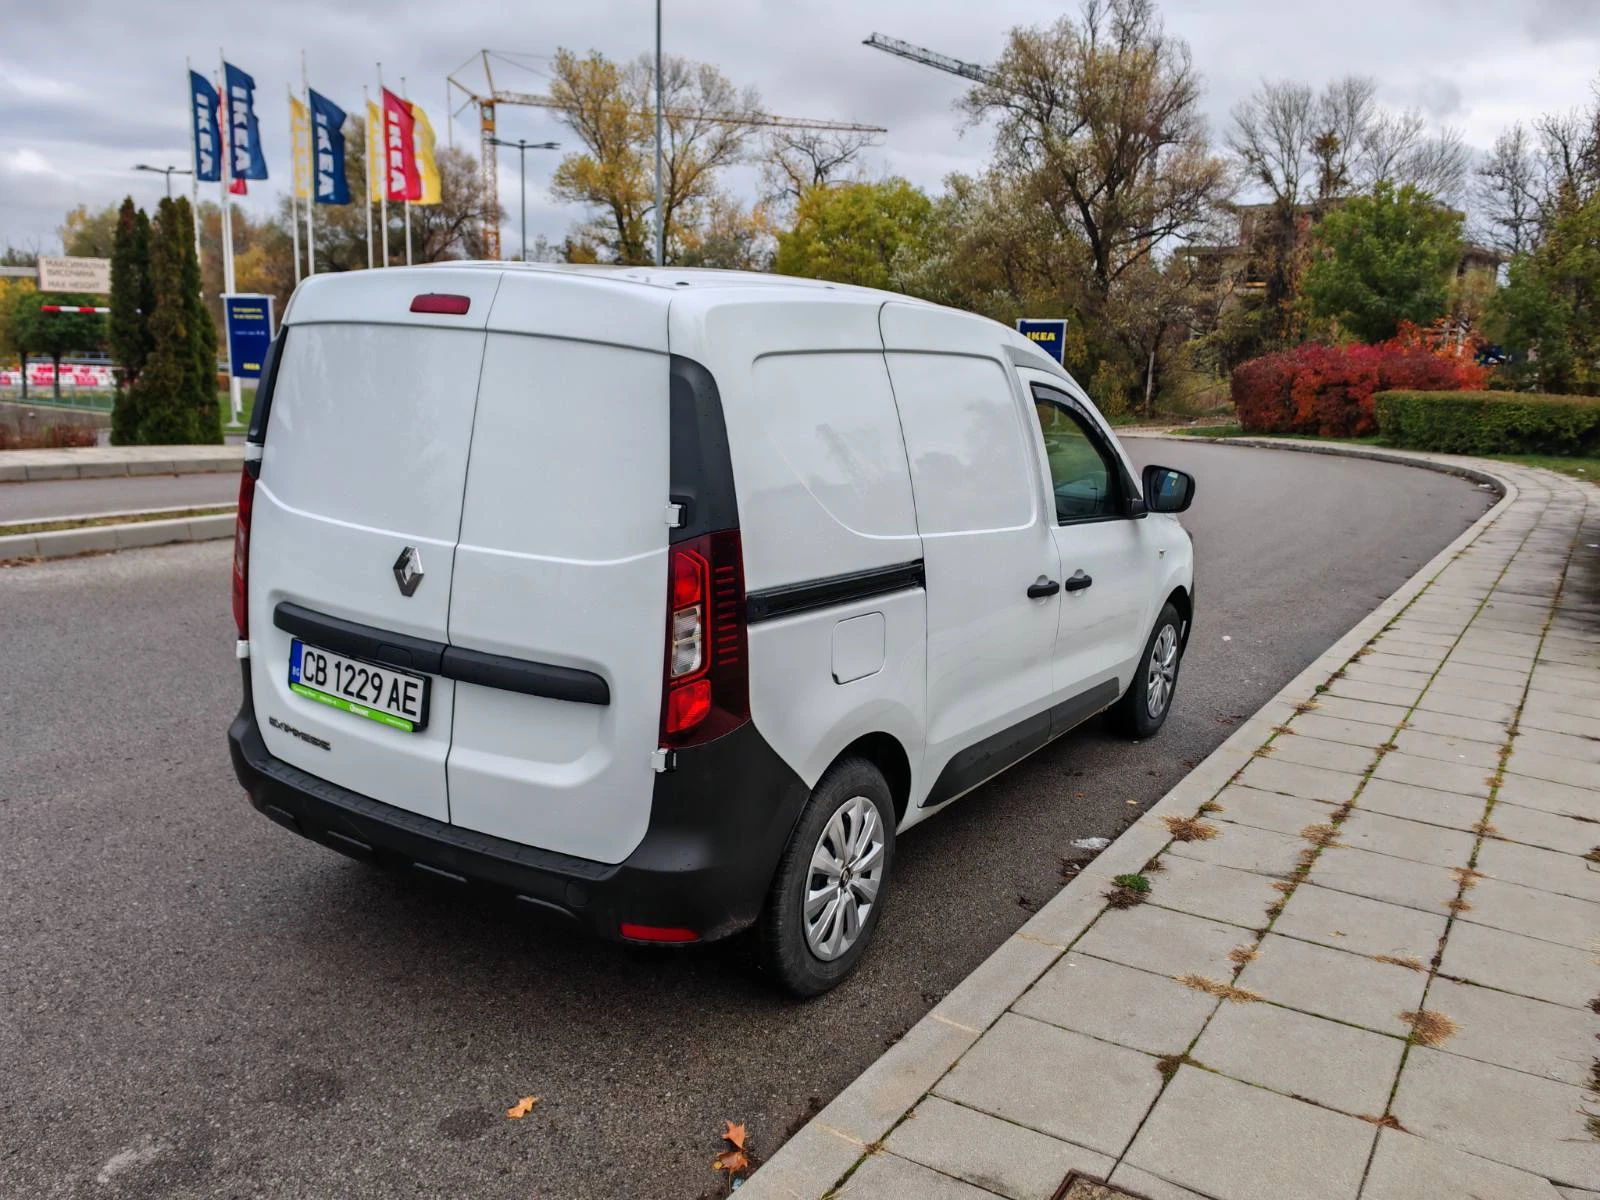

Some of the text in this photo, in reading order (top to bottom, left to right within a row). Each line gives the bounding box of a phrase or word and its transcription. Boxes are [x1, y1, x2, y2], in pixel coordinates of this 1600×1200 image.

[196, 92, 213, 174] IKEA
[232, 85, 251, 172] IKEA
[316, 112, 334, 196] IKEA
[388, 110, 406, 193] IKEA
[1027, 332, 1055, 341] IKEA
[303, 651, 418, 716] CB 1229 AE
